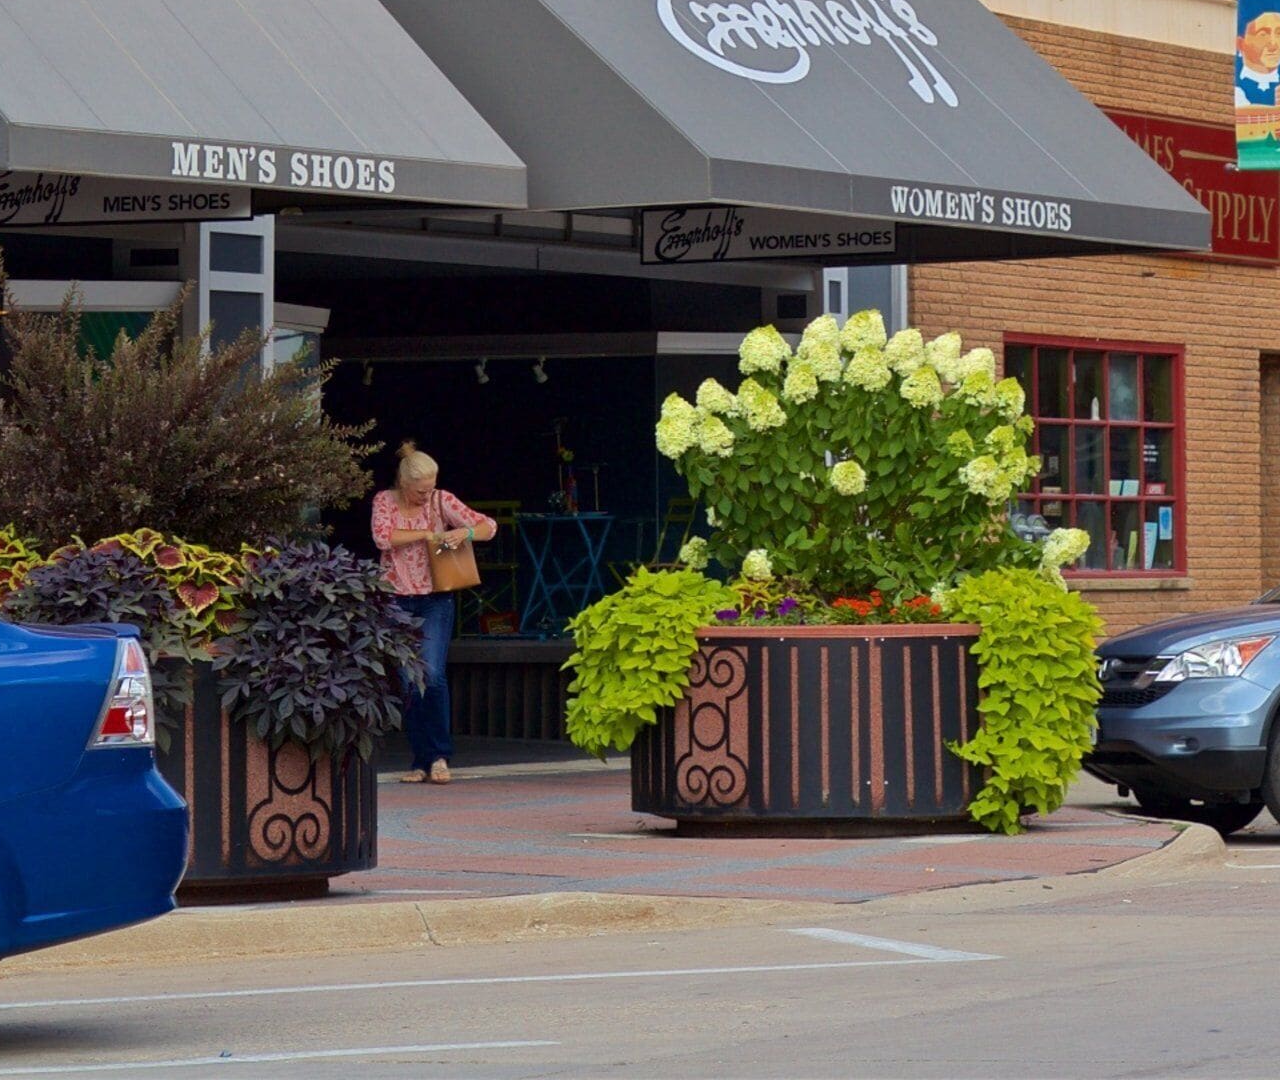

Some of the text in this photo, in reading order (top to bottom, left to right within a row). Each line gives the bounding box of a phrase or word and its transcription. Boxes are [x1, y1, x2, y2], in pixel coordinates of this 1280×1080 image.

[172, 142, 395, 193] MEN'S SHOES
[103, 195, 161, 213] MEN'S
[168, 192, 230, 211] SHOES
[891, 185, 1072, 231] WOMEN'S SHOES
[1183, 177, 1276, 244] PPLY
[750, 233, 831, 251] WOMEN'S
[837, 230, 892, 247] SHOES
